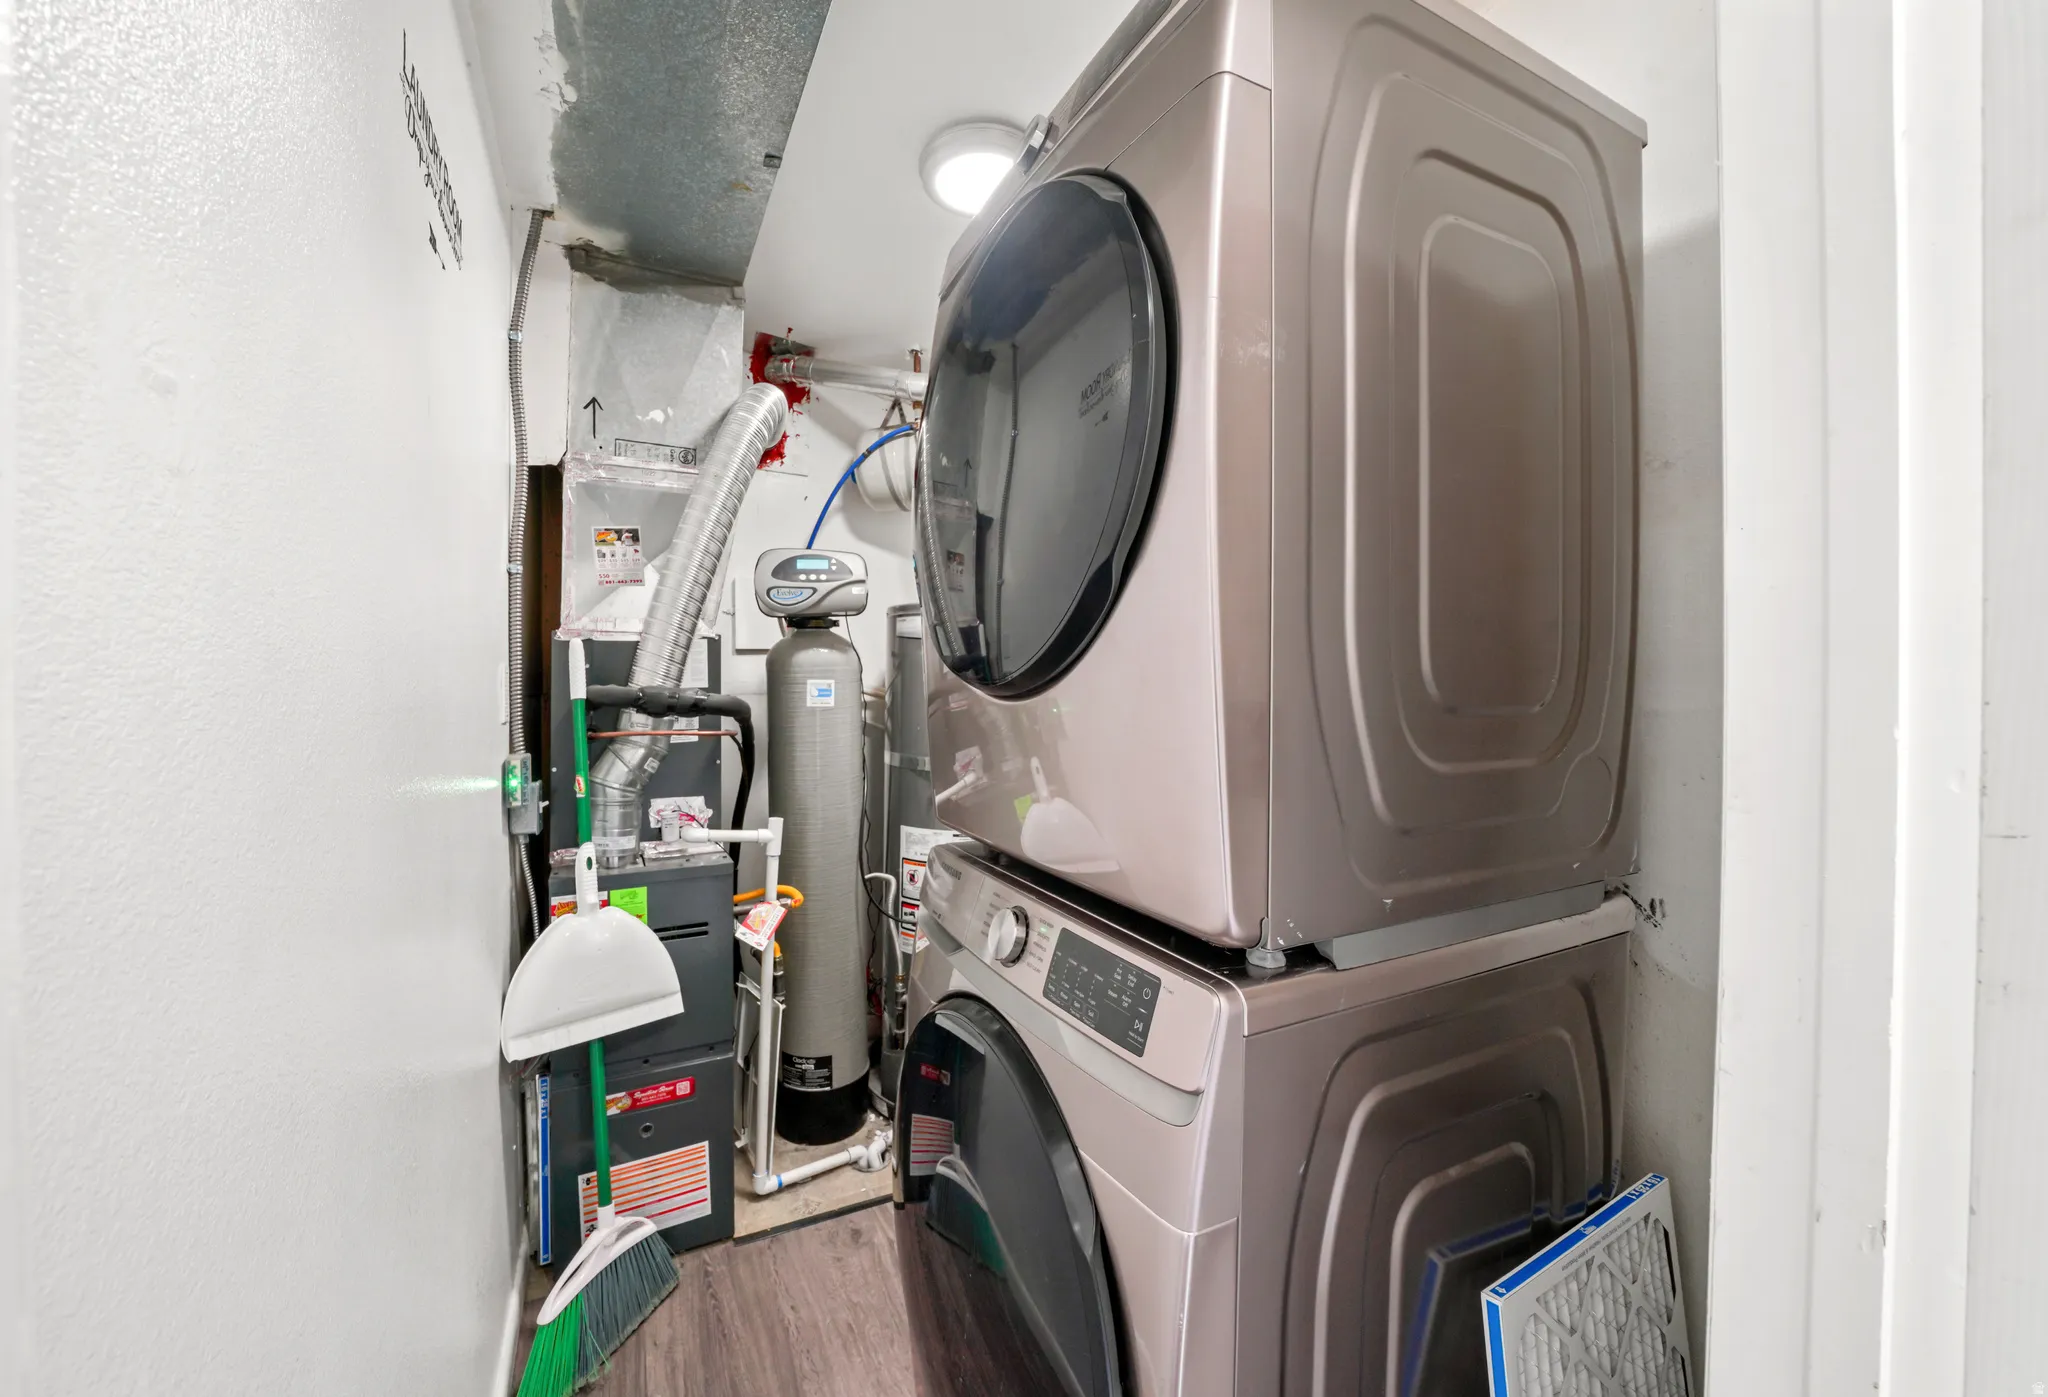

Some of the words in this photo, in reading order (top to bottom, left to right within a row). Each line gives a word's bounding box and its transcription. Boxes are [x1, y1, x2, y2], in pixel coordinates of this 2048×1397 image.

[402, 28, 443, 181] LAUNDRY
[442, 159, 463, 248] ROOM
[776, 588, 799, 598] Evolve
[1127, 973, 1138, 983] Delay
[1121, 994, 1132, 1003] Alarm
